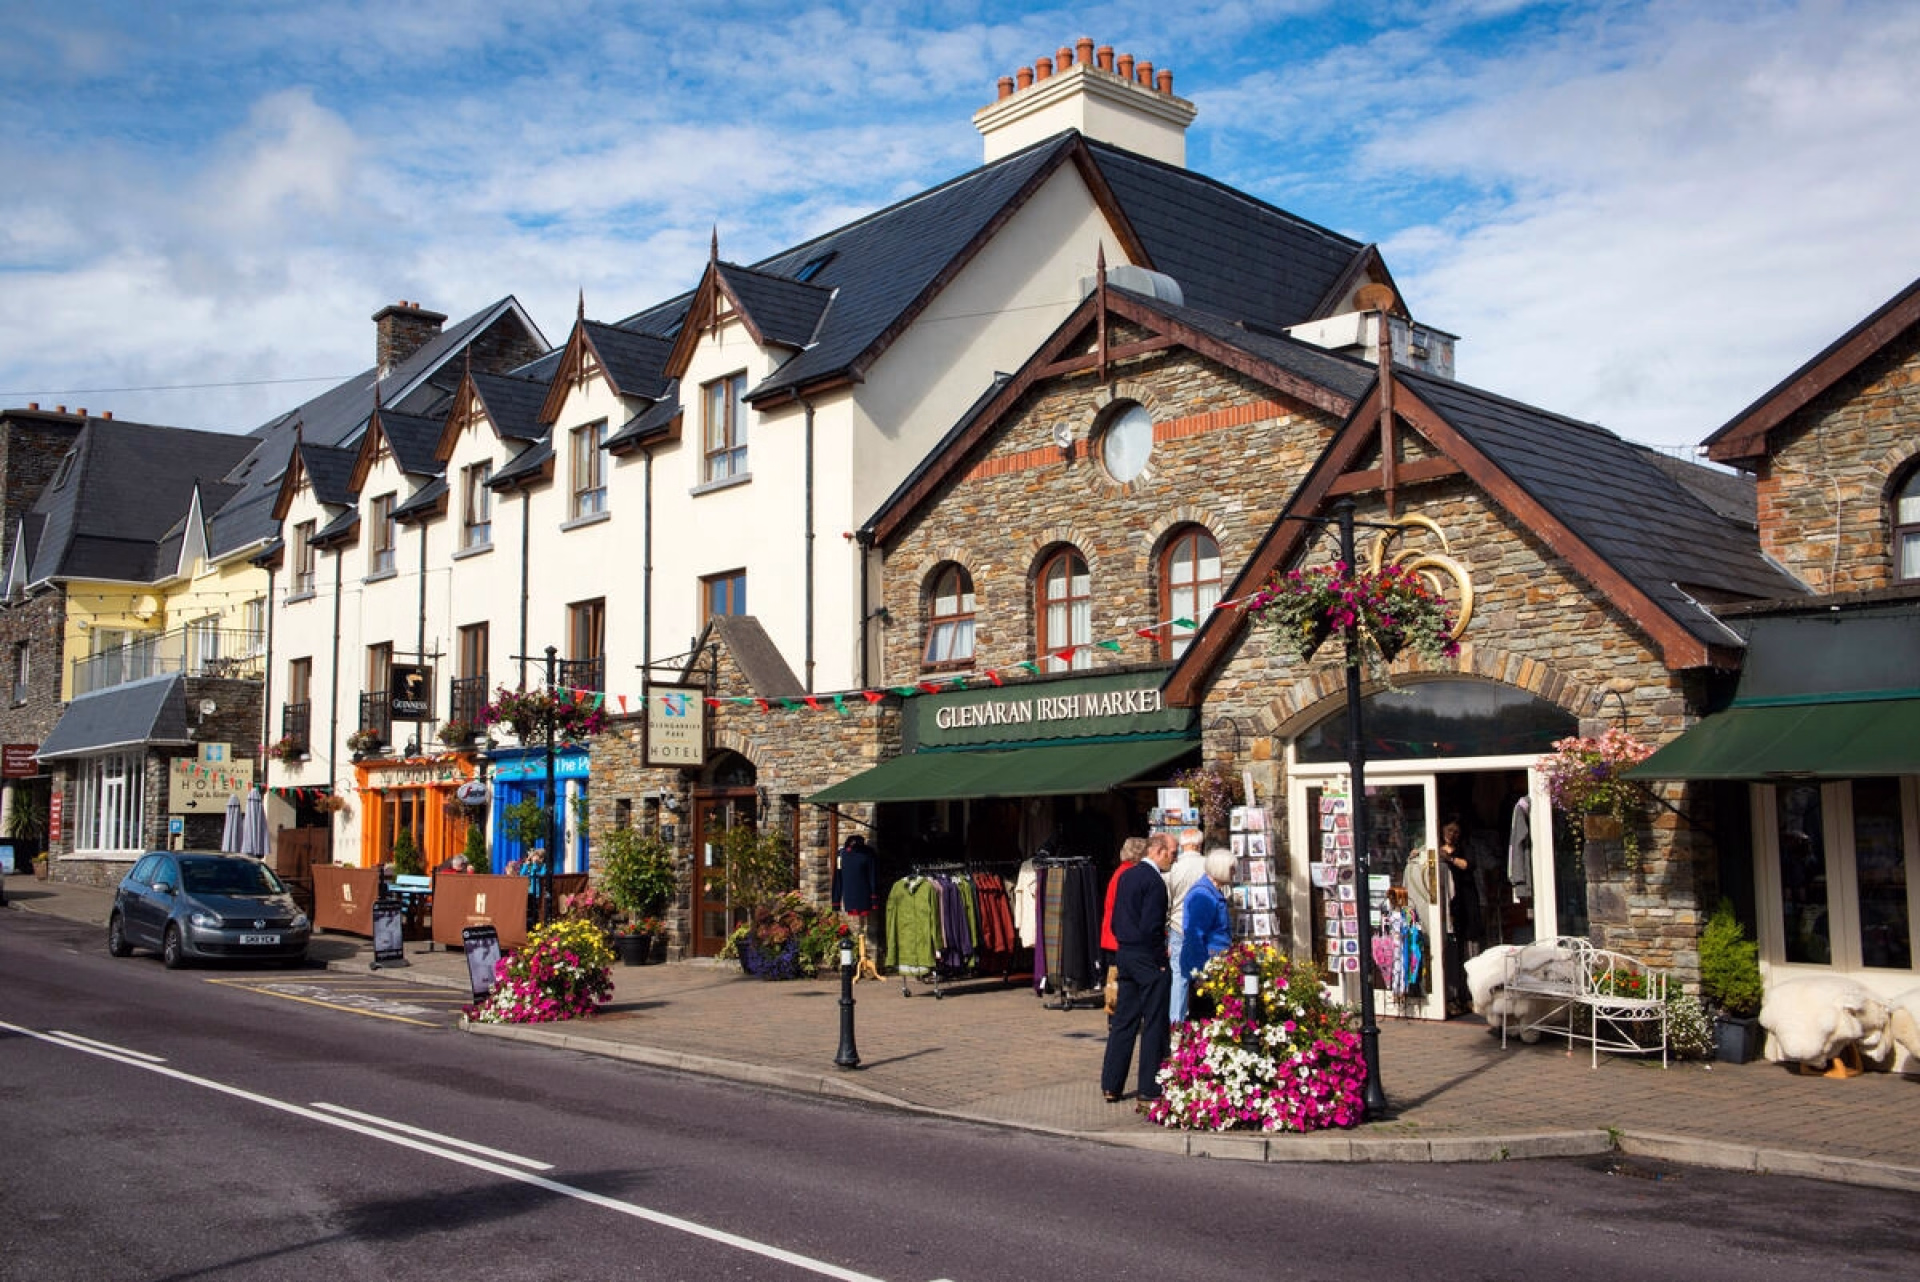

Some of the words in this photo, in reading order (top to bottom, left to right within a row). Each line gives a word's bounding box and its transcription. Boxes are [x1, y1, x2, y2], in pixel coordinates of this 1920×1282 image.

[935, 699, 1033, 729] GLENARAN
[1037, 695, 1080, 721] IRISH
[1085, 688, 1162, 717] MARKET
[650, 746, 699, 758] HOTEL
[554, 757, 576, 773] The
